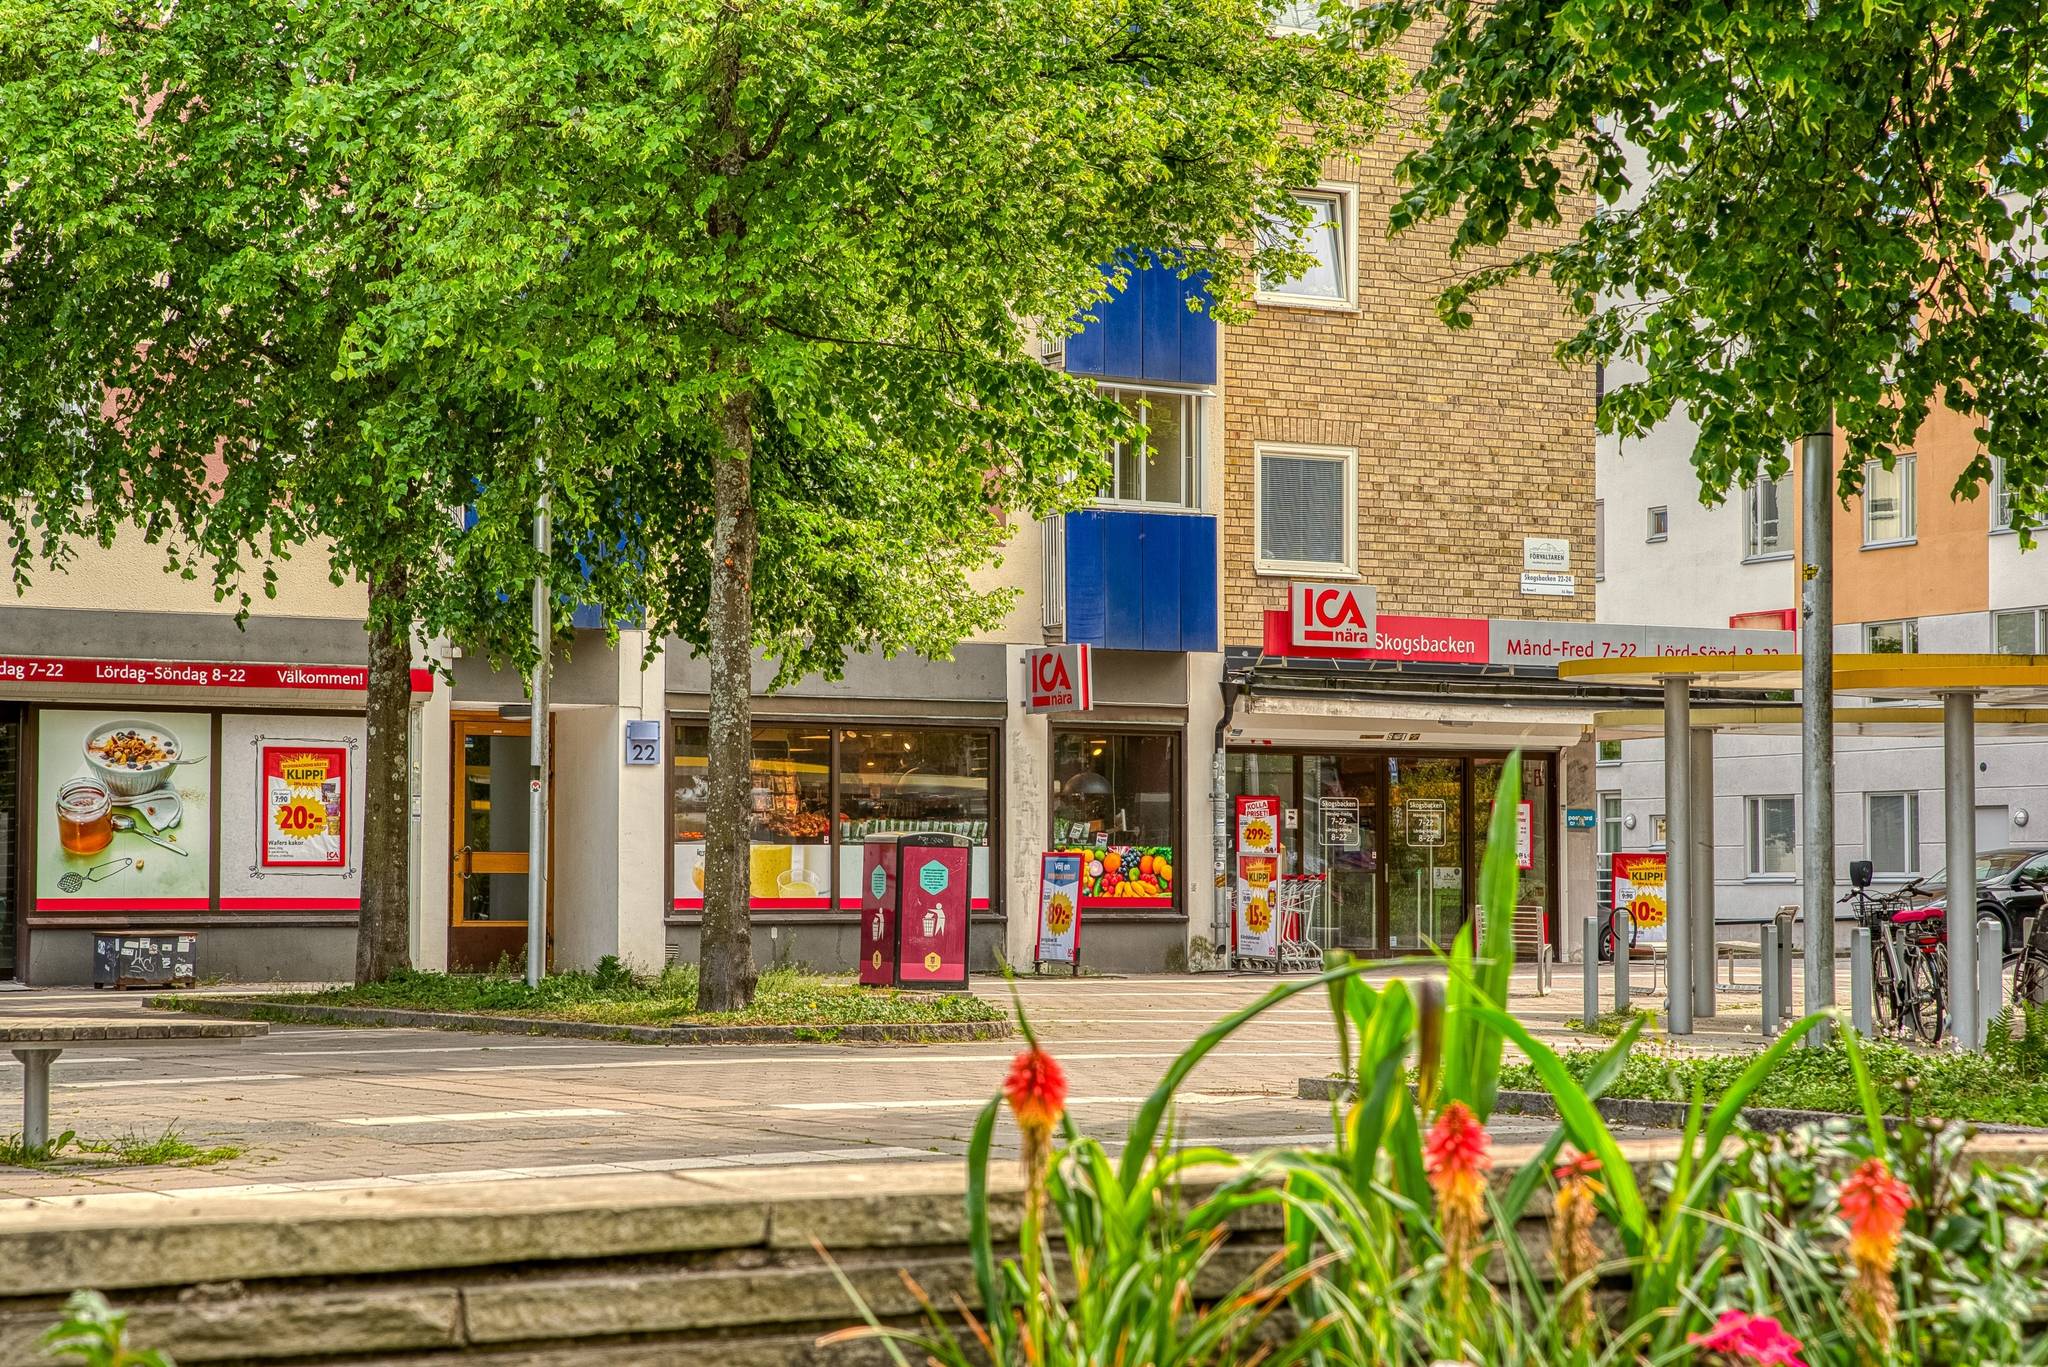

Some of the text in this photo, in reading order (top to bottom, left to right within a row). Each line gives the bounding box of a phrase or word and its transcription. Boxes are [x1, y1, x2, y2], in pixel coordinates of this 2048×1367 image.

[1524, 574, 1556, 582] Skogsbacken
[1304, 588, 1367, 628] ICA
[1335, 629, 1368, 643] nära
[1375, 633, 1475, 655] Skogsbacken
[1507, 639, 1594, 657] Månd-Fred
[1602, 642, 1637, 658] 7-22
[29, 663, 64, 677] 7-22
[96, 665, 208, 685] Lördag-Söndag
[212, 668, 246, 682] 8-22
[277, 670, 363, 685] Välkommen!
[1031, 652, 1072, 693] ICA
[1050, 689, 1072, 705] nära
[632, 745, 656, 761] 22
[287, 769, 323, 780] KLIPP!
[1246, 800, 1267, 810] KOLLA
[1321, 800, 1356, 808] Skogsbacken
[280, 805, 323, 830] 20:-
[1331, 817, 1347, 825] 7-22
[1246, 828, 1270, 840] 299:-
[1331, 833, 1347, 841] 8-22
[1632, 872, 1663, 881] KLIPP!
[1048, 903, 1069, 924] 89:-
[1249, 904, 1267, 926] 15:-
